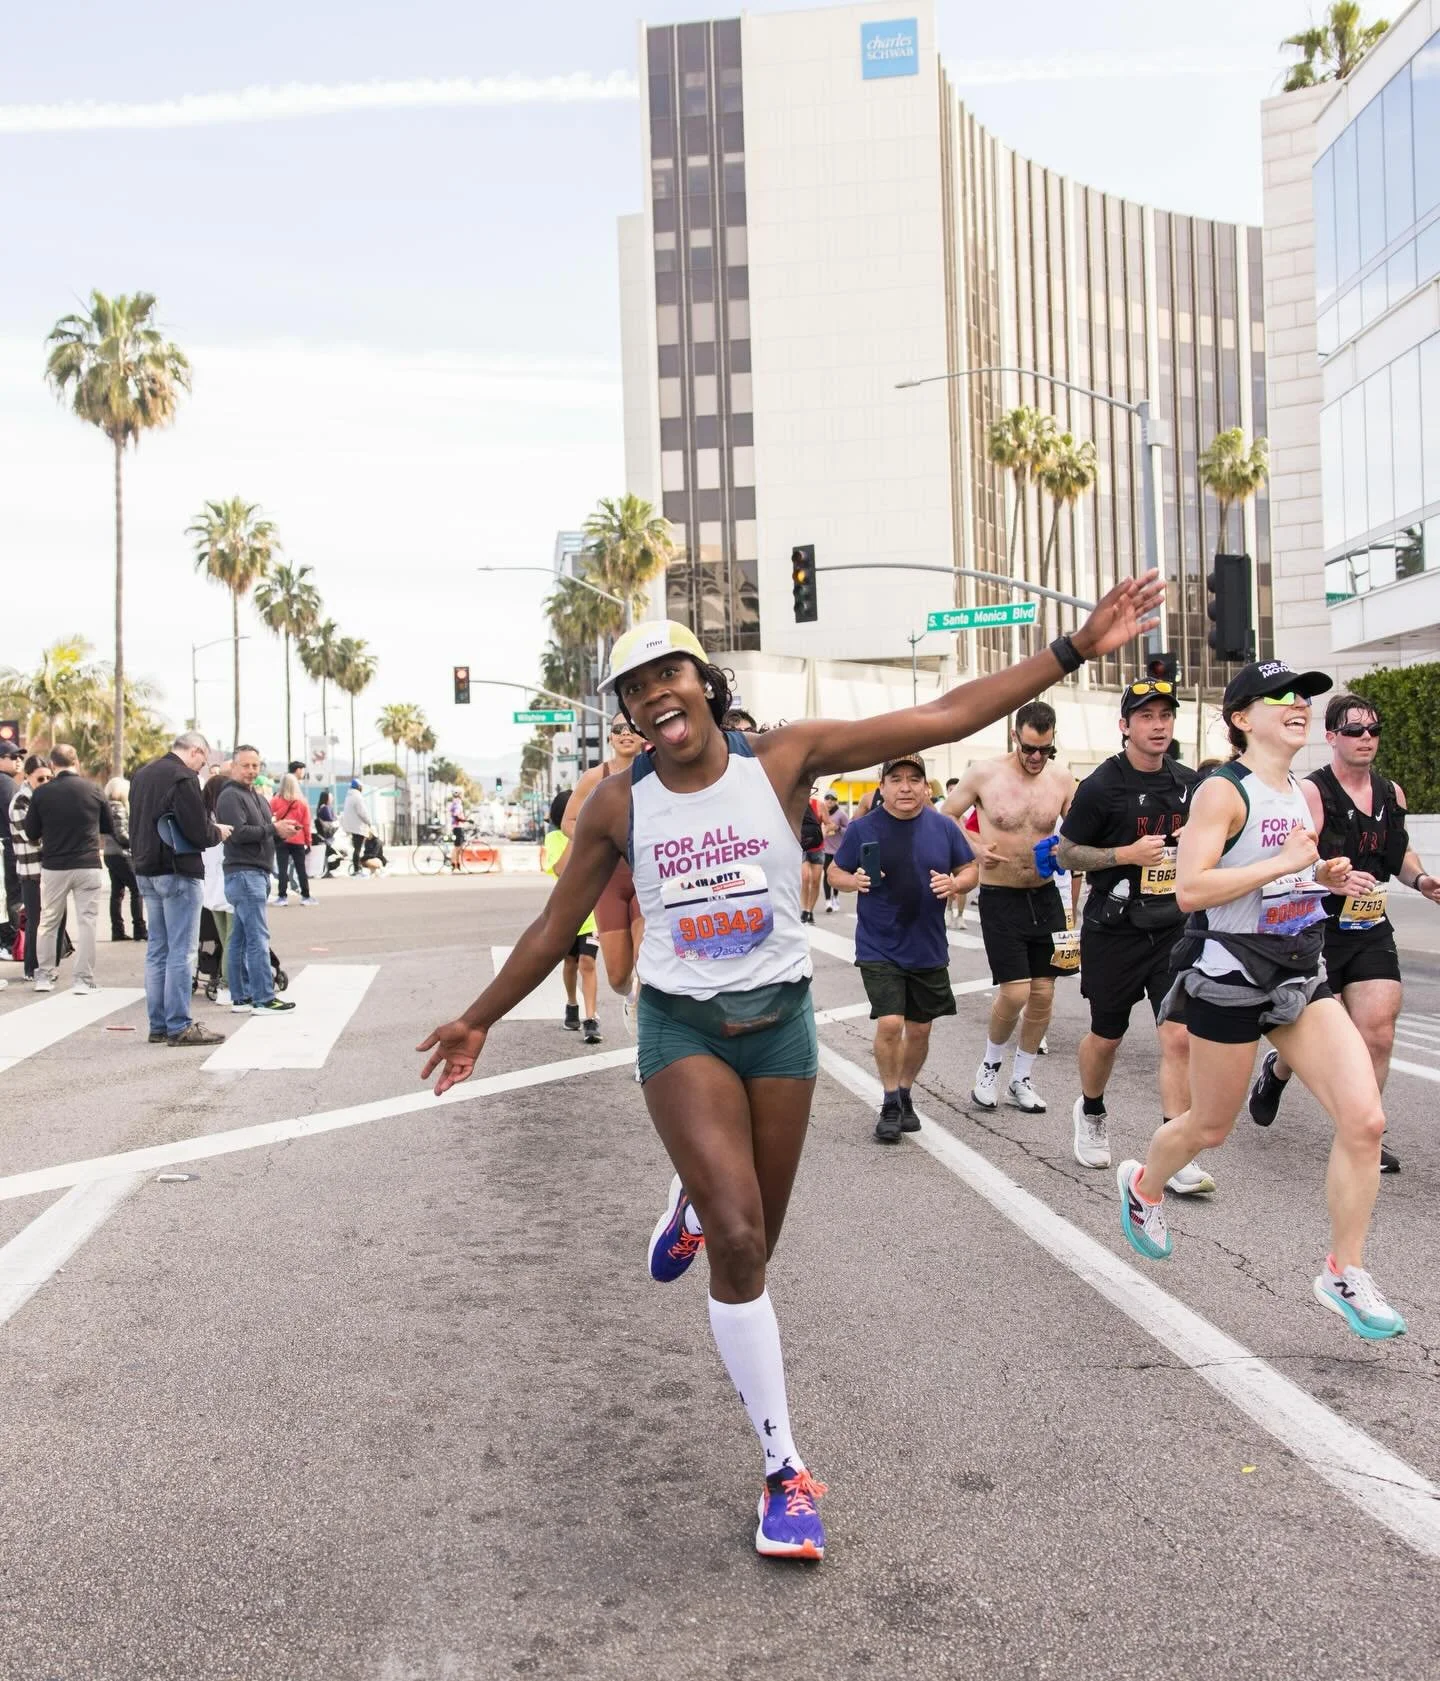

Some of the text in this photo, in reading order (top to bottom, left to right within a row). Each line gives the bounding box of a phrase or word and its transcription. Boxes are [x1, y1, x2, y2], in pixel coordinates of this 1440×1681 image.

[928, 606, 1035, 627] S. Santa Monica Blvd
[1258, 662, 1279, 673] FOR
[1261, 818, 1288, 833] FOR
[654, 825, 740, 861] FOR ALL
[658, 838, 770, 879] MOTHERS+
[695, 871, 741, 888] CHARITY
[1351, 899, 1383, 912] E7513
[679, 906, 766, 942] 90342
